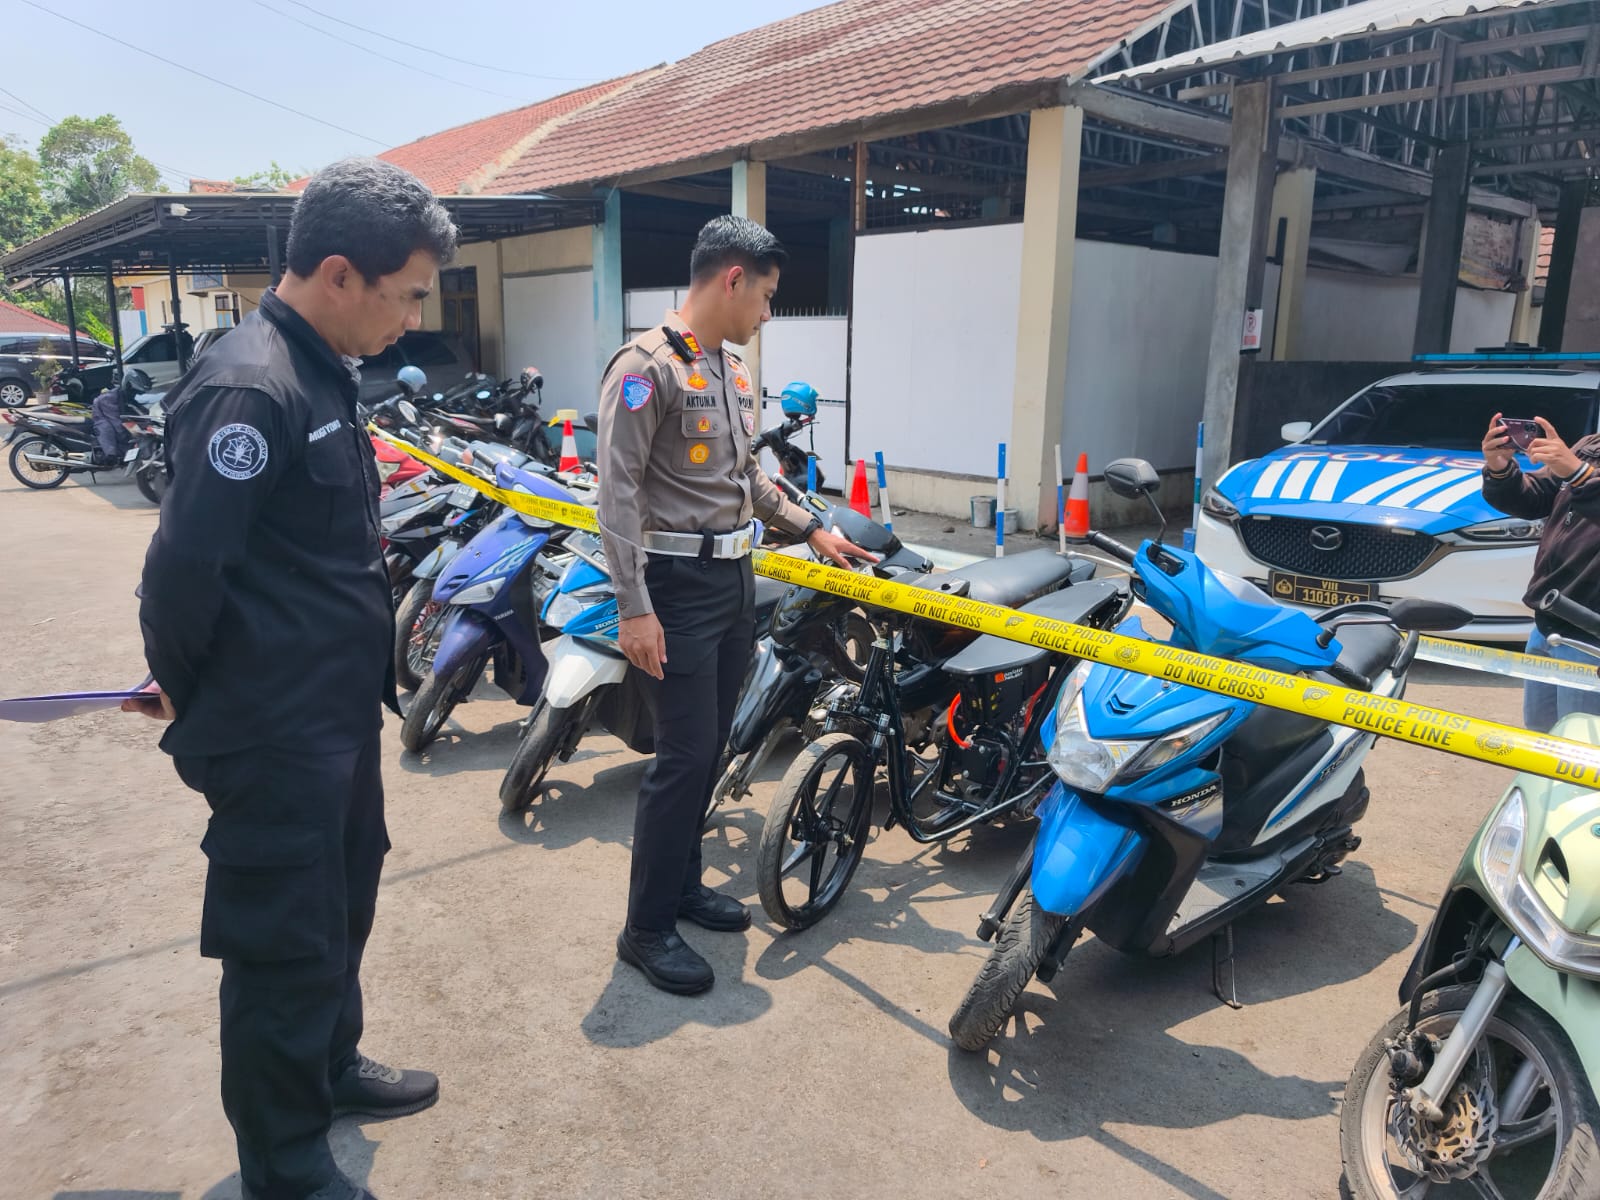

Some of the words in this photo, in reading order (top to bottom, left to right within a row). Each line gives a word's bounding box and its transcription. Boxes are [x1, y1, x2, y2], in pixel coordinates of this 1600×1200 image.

[1284, 451, 1484, 469] POLIS
[768, 564, 792, 581] CROSS
[826, 570, 853, 582] GARIS
[853, 576, 883, 590] POLISI
[824, 579, 852, 597] POLICE
[852, 588, 874, 601] LINE
[1321, 580, 1339, 591] VIII
[908, 588, 953, 607] DILARANG
[954, 600, 1006, 619] MELINTAS
[913, 601, 928, 615] DO
[928, 605, 949, 620] NOT
[949, 611, 983, 629] CROSS
[594, 617, 620, 631] HOND
[1033, 618, 1072, 635] GARIS
[1072, 627, 1116, 645] POLISI
[1030, 630, 1072, 651] POLICE
[1073, 640, 1103, 658] LINE
[1153, 647, 1223, 671] DILARANG
[1224, 663, 1298, 690] MELINTAS
[1163, 663, 1184, 679] DO
[1186, 669, 1217, 687] NOT
[1217, 677, 1268, 700] CROSS
[1343, 692, 1401, 714] GARIS
[1405, 706, 1472, 732] POLISI
[1342, 706, 1407, 735] POLICE
[1409, 723, 1455, 747] LINE
[1555, 758, 1587, 779] DO
[1171, 784, 1218, 807] HONDA
